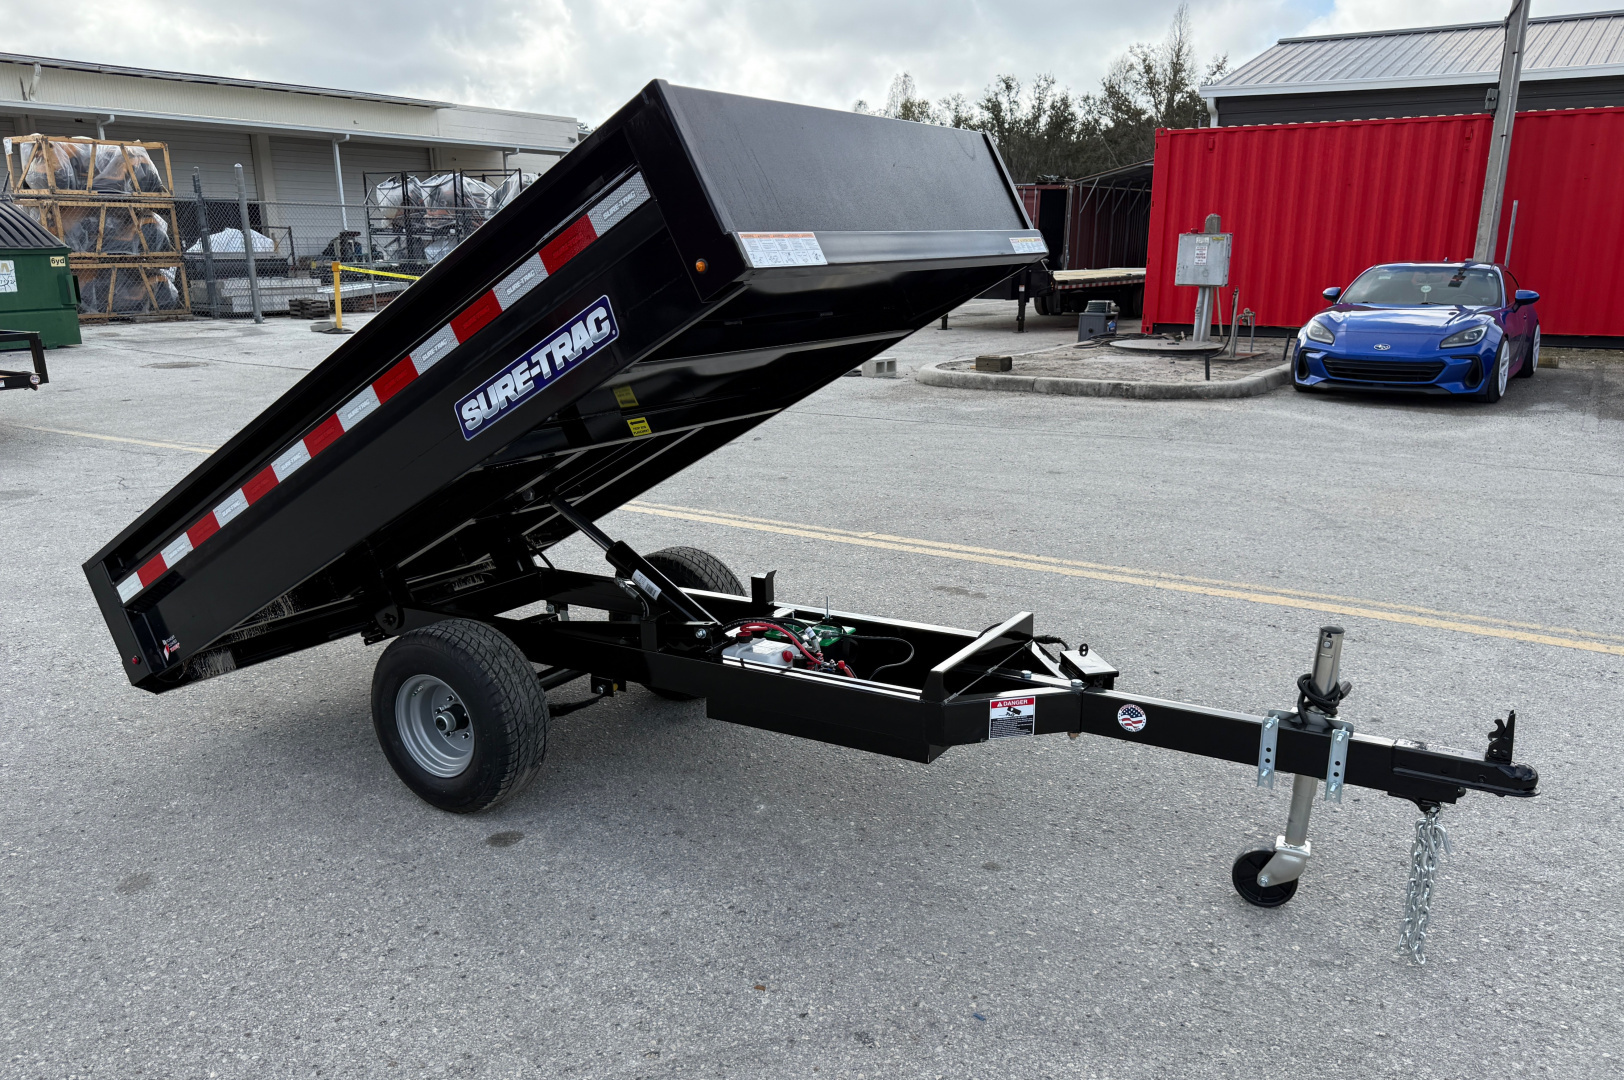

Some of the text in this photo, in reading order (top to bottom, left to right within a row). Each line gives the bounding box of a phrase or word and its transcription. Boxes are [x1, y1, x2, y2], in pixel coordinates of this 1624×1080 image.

[602, 190, 636, 221] SURE-TRAC
[506, 269, 536, 296] SURE-TRAC
[421, 336, 449, 362] SURE-TRAC
[461, 306, 611, 431] SURE-TRAC
